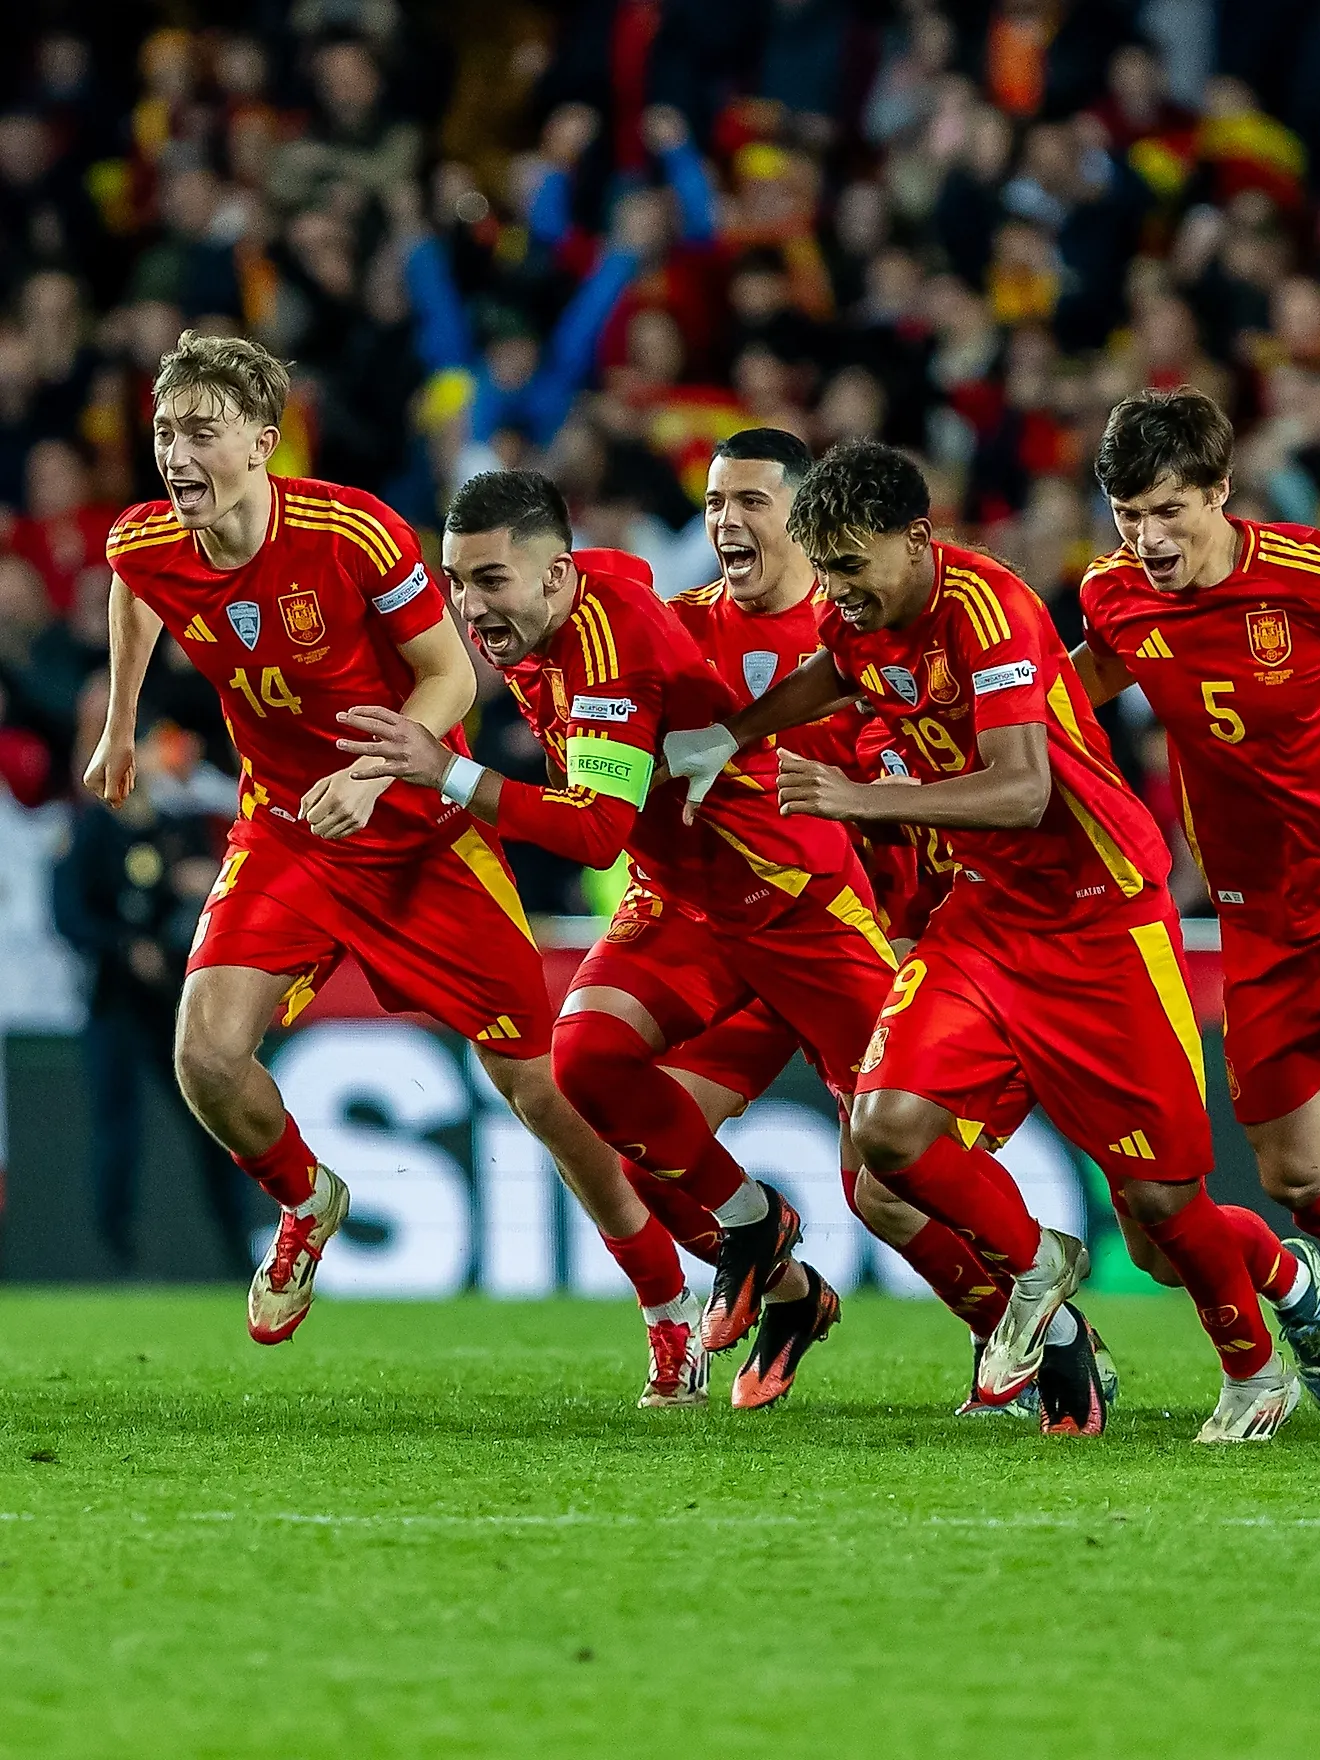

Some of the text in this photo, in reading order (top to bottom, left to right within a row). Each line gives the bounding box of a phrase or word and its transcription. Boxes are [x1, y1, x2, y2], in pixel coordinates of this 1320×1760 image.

[229, 666, 303, 718] 14
[608, 703, 627, 716] 10
[1201, 681, 1246, 744] 5
[578, 758, 632, 778] RESPECT
[900, 716, 966, 772] 19
